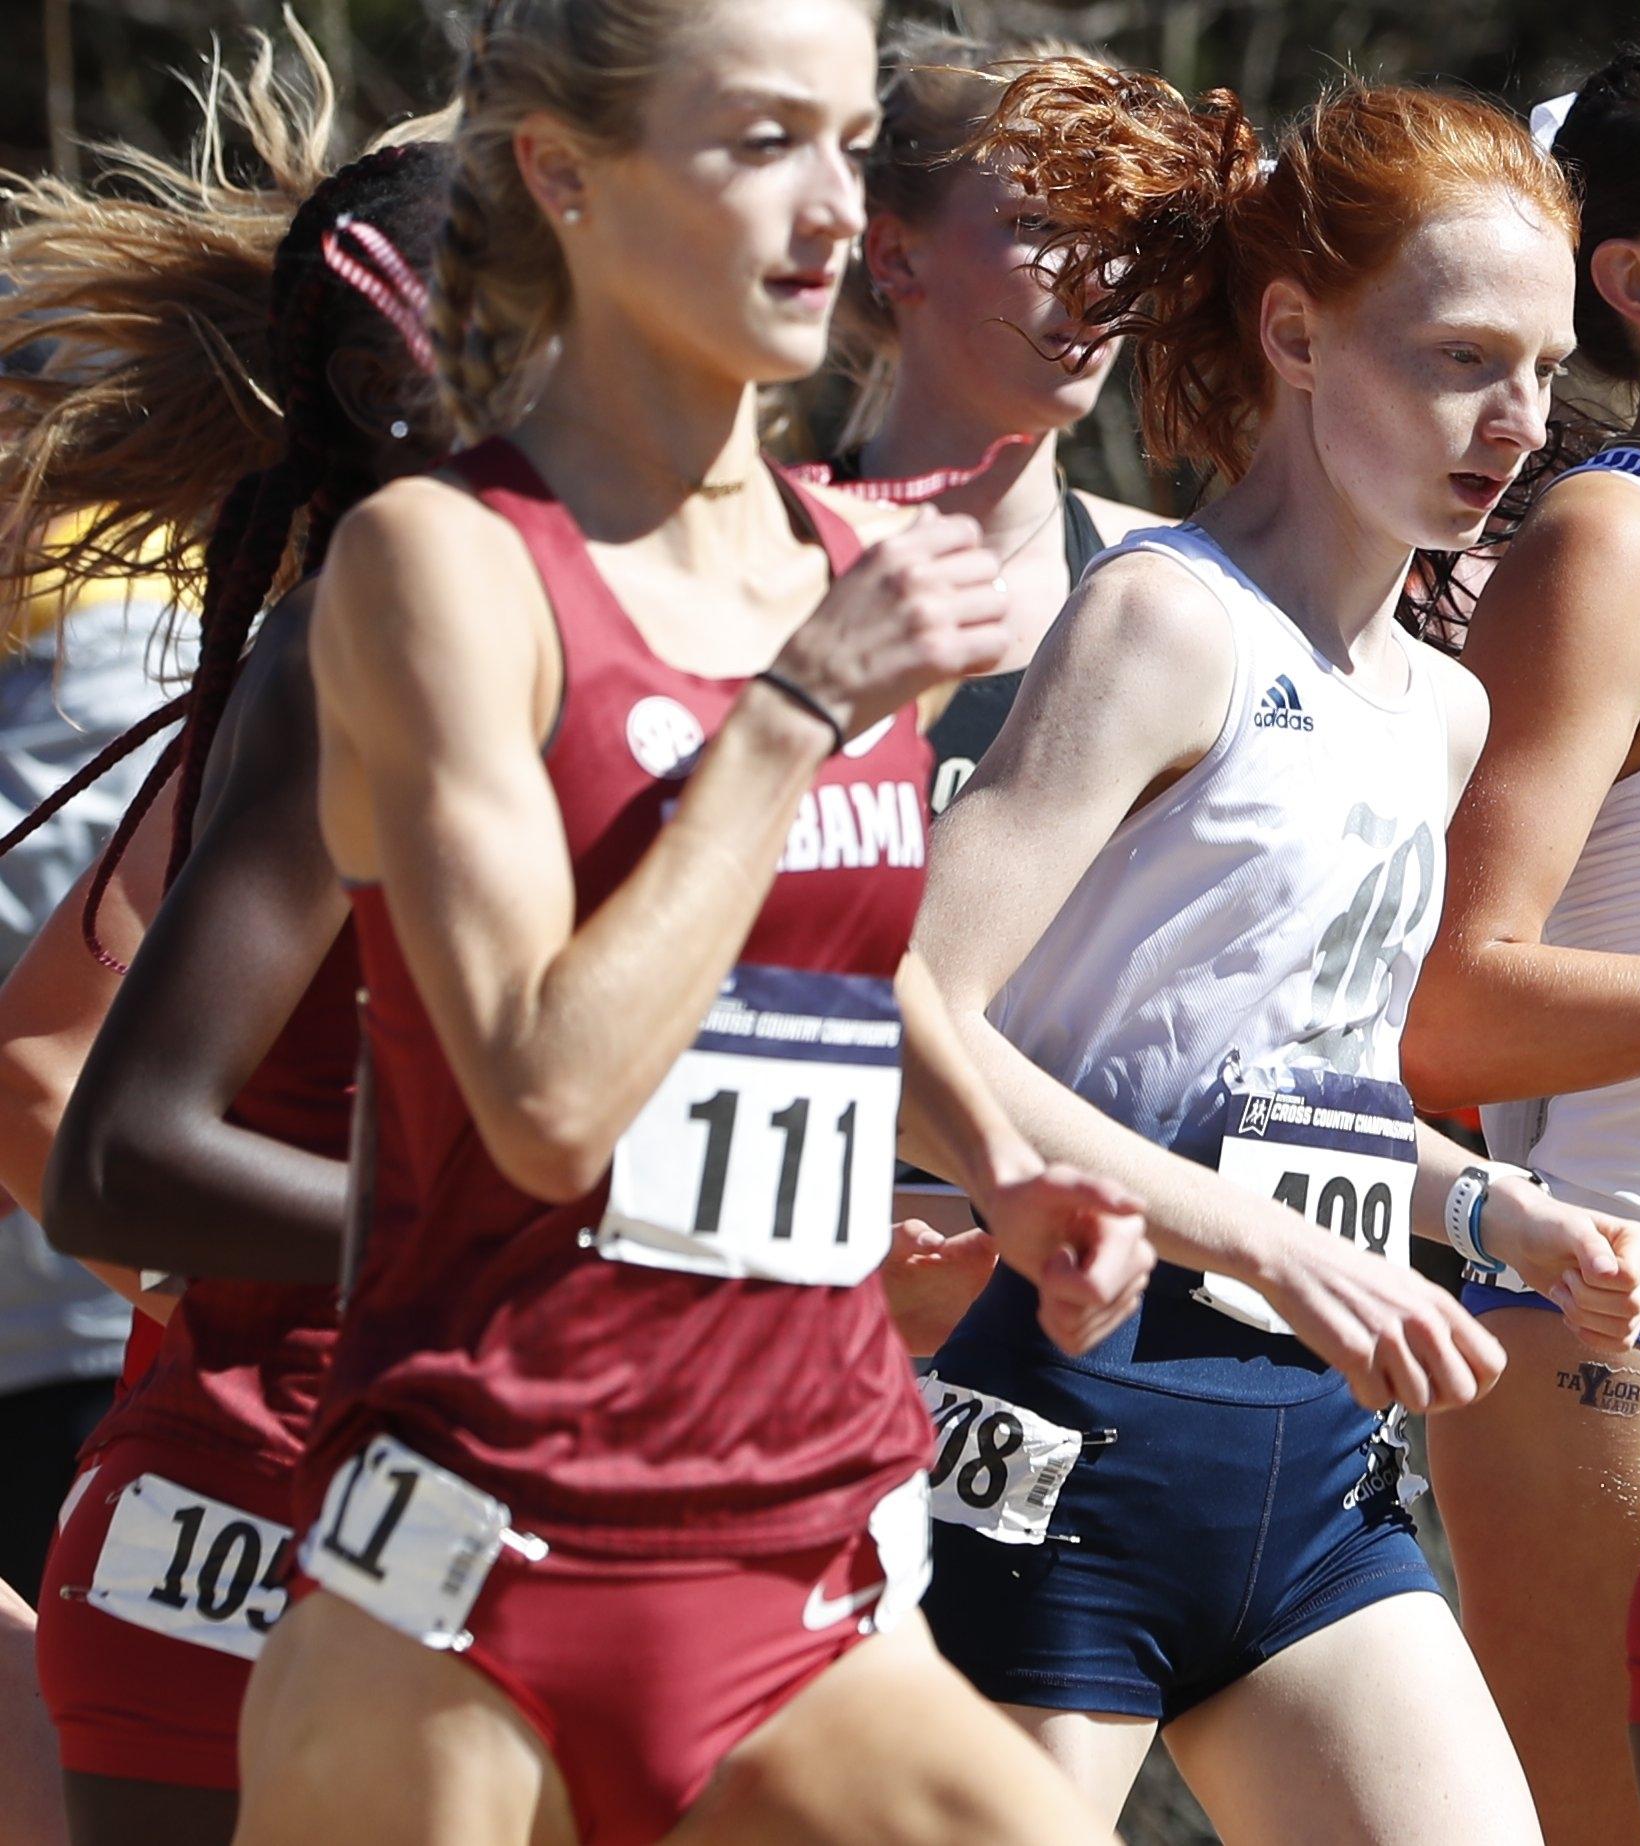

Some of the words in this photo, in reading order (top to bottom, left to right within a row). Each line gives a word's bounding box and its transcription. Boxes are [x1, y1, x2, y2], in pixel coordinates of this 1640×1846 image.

[776, 780, 925, 873] BAMA
[1270, 1102, 1313, 1125] CROSS
[1312, 1107, 1356, 1131] COUNTRY
[688, 1089, 857, 1245] 111
[1557, 1363, 1640, 1406] TAYLOR
[930, 1392, 1024, 1509] 08
